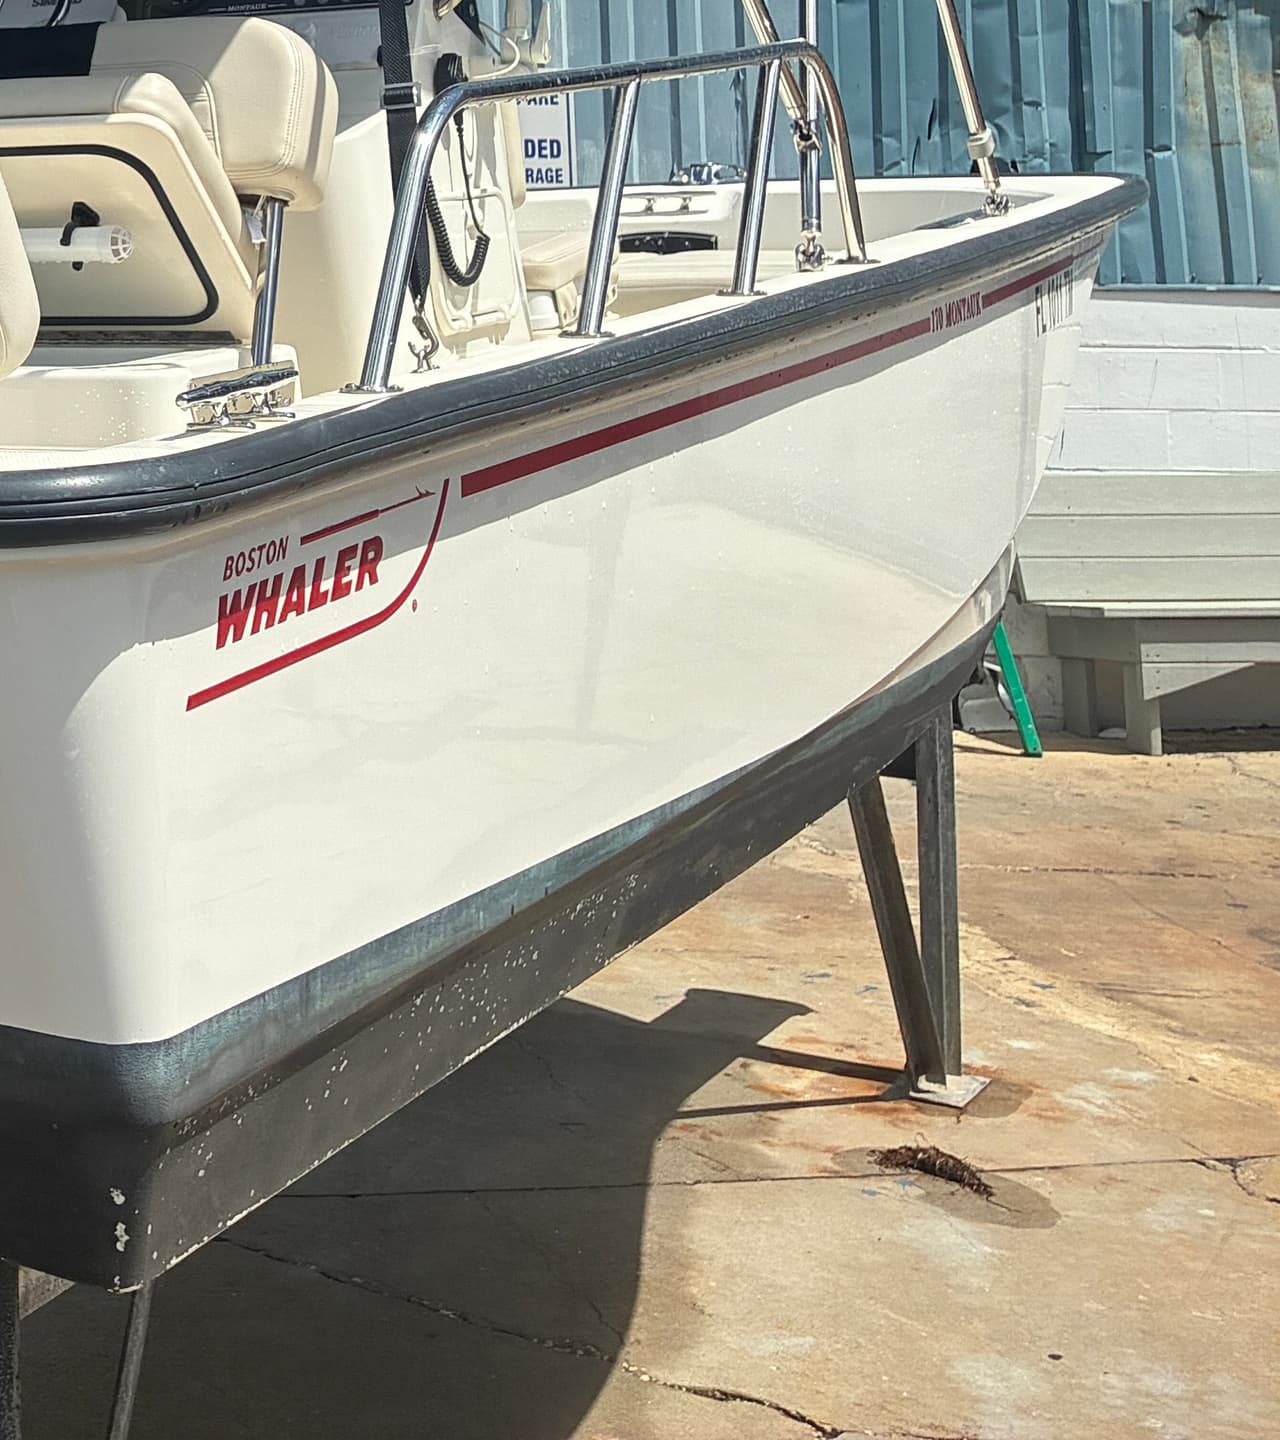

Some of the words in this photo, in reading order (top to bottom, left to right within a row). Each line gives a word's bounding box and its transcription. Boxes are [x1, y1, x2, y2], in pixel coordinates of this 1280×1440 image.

[525, 167, 564, 184] RAGE
[945, 291, 982, 329] MONTAUK
[223, 535, 289, 582] BOSTON
[215, 535, 384, 650] WHALER
